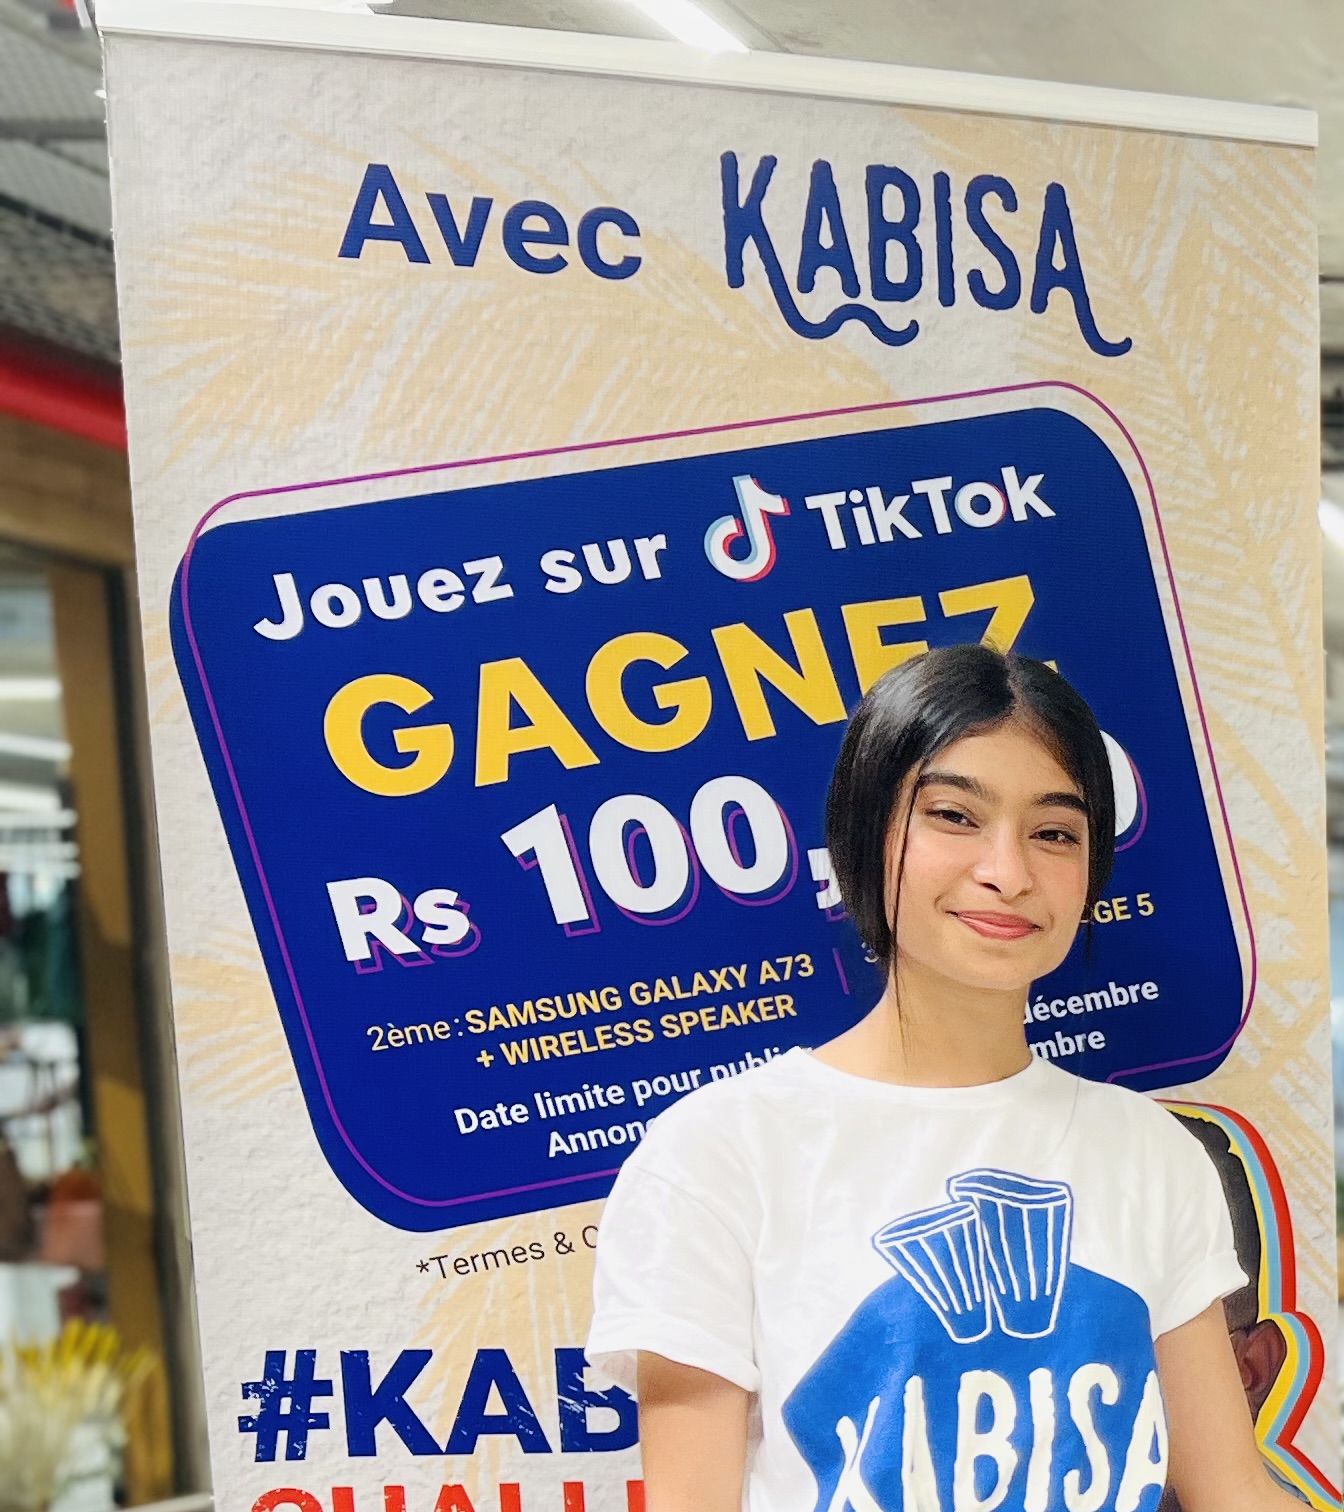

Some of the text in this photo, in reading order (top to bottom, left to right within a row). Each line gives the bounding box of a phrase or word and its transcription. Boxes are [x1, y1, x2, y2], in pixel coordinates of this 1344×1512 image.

[338, 151, 1132, 358] Avec KABISA
[253, 466, 1056, 642] Jouez sur TikTok
[326, 876, 472, 962] Rs
[1136, 893, 1155, 917] 5
[466, 986, 622, 1035] SAMSUNG
[641, 964, 749, 1006] GALAXY
[759, 953, 815, 985] A73
[500, 1018, 655, 1067] WIRELESS
[661, 994, 798, 1039] SPEAKER
[454, 1100, 529, 1136] Date
[533, 1083, 626, 1120] limite
[631, 1067, 702, 1107] pour
[553, 1230, 577, 1256] &
